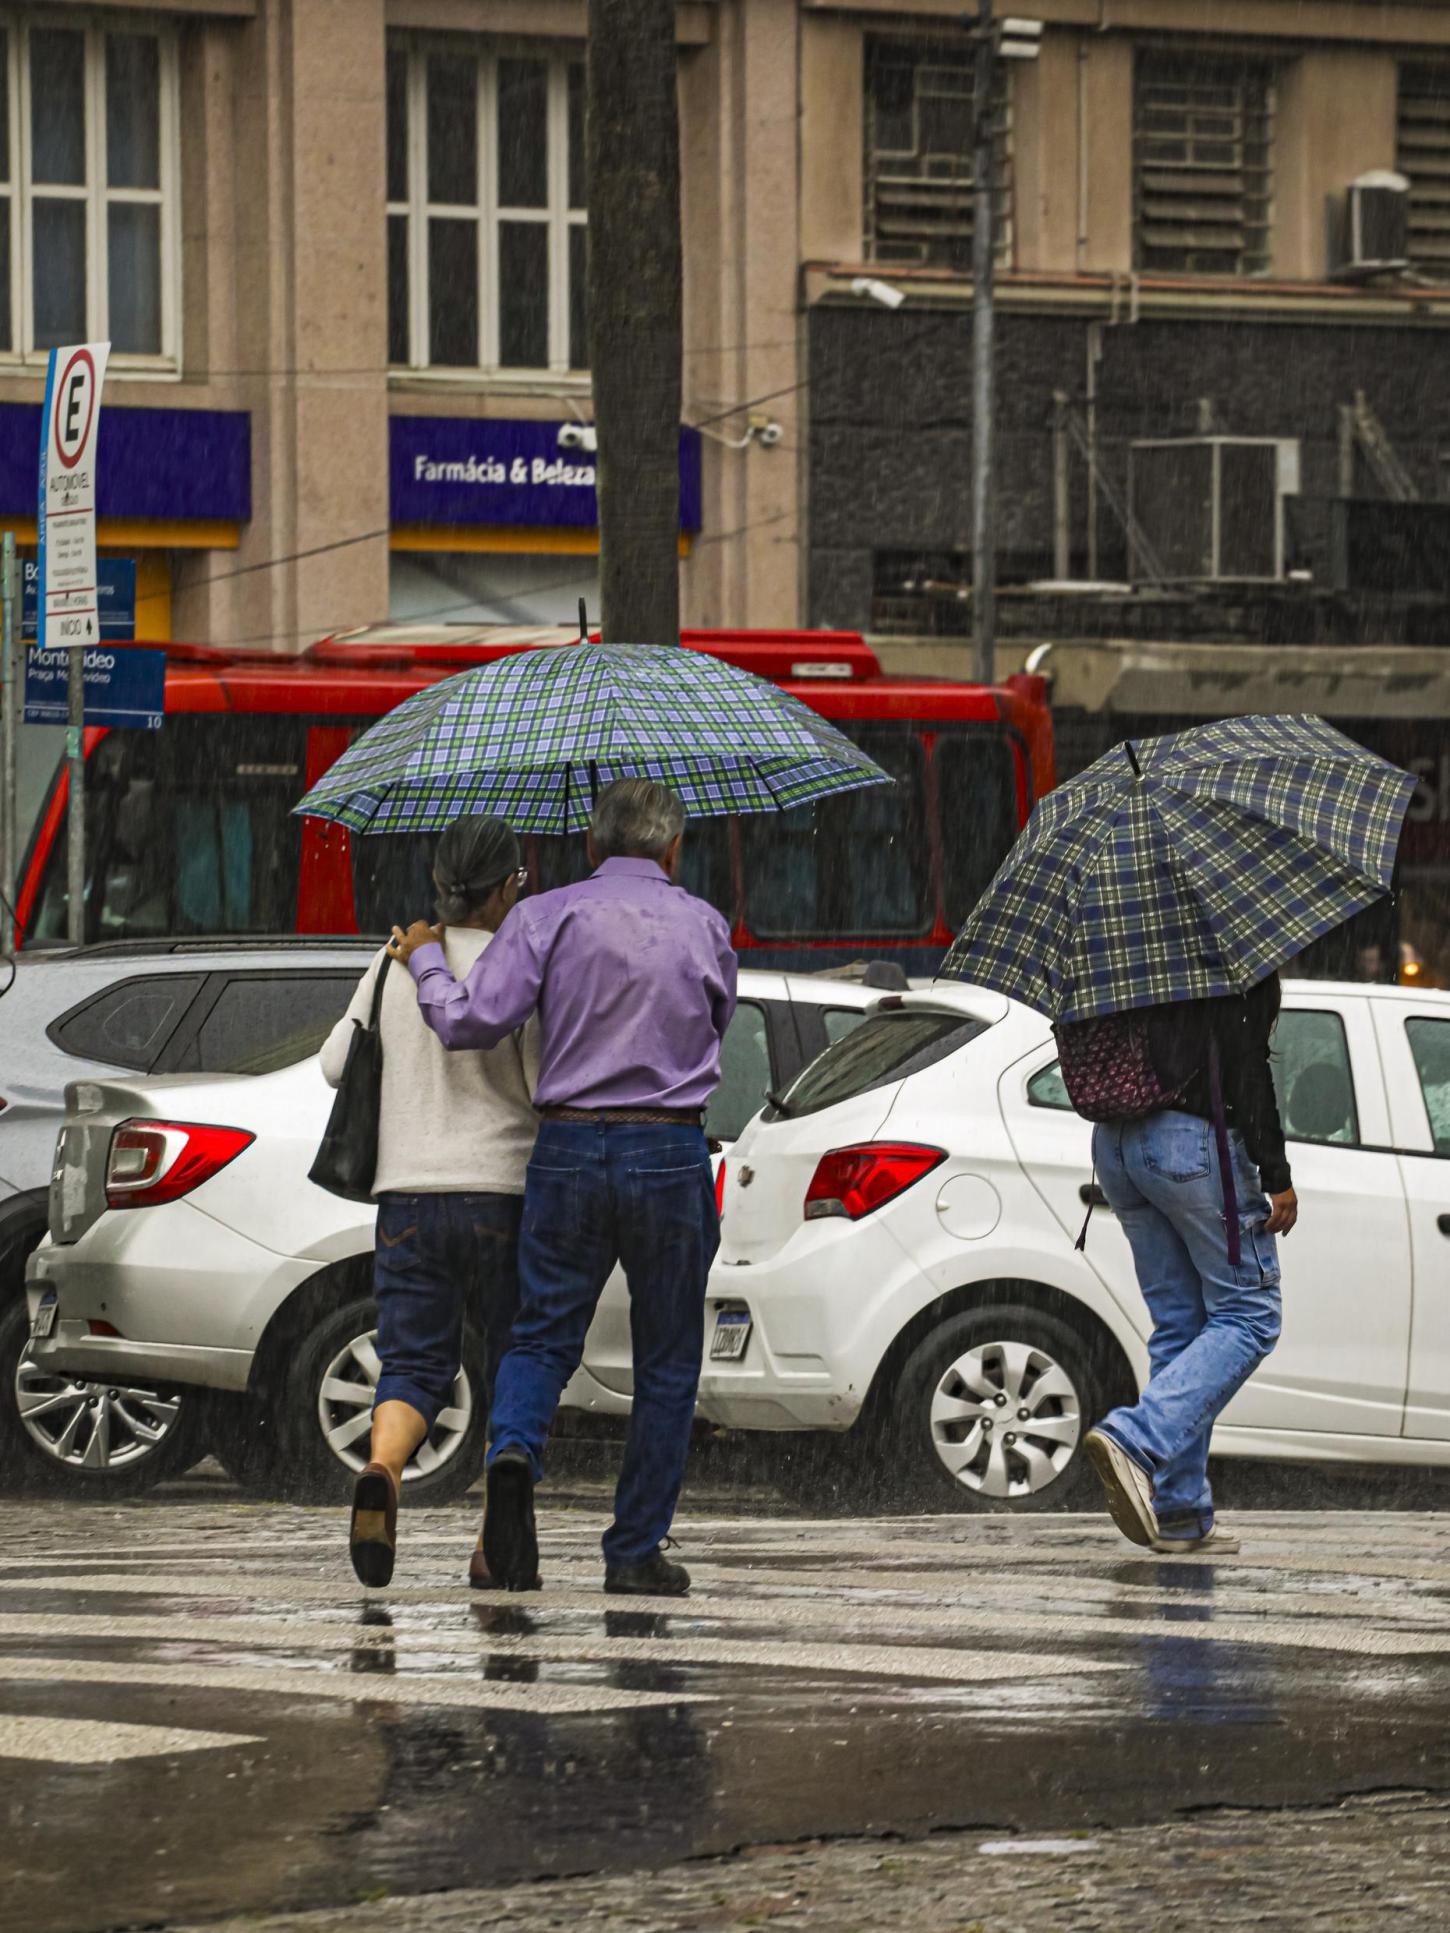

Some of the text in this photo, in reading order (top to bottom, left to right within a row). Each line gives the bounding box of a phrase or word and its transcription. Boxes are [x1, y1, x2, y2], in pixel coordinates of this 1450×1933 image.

[65, 375, 85, 442] E
[415, 455, 595, 486] Farmácia & Beleza
[28, 647, 115, 669] Montideo
[147, 715, 162, 729] 10
